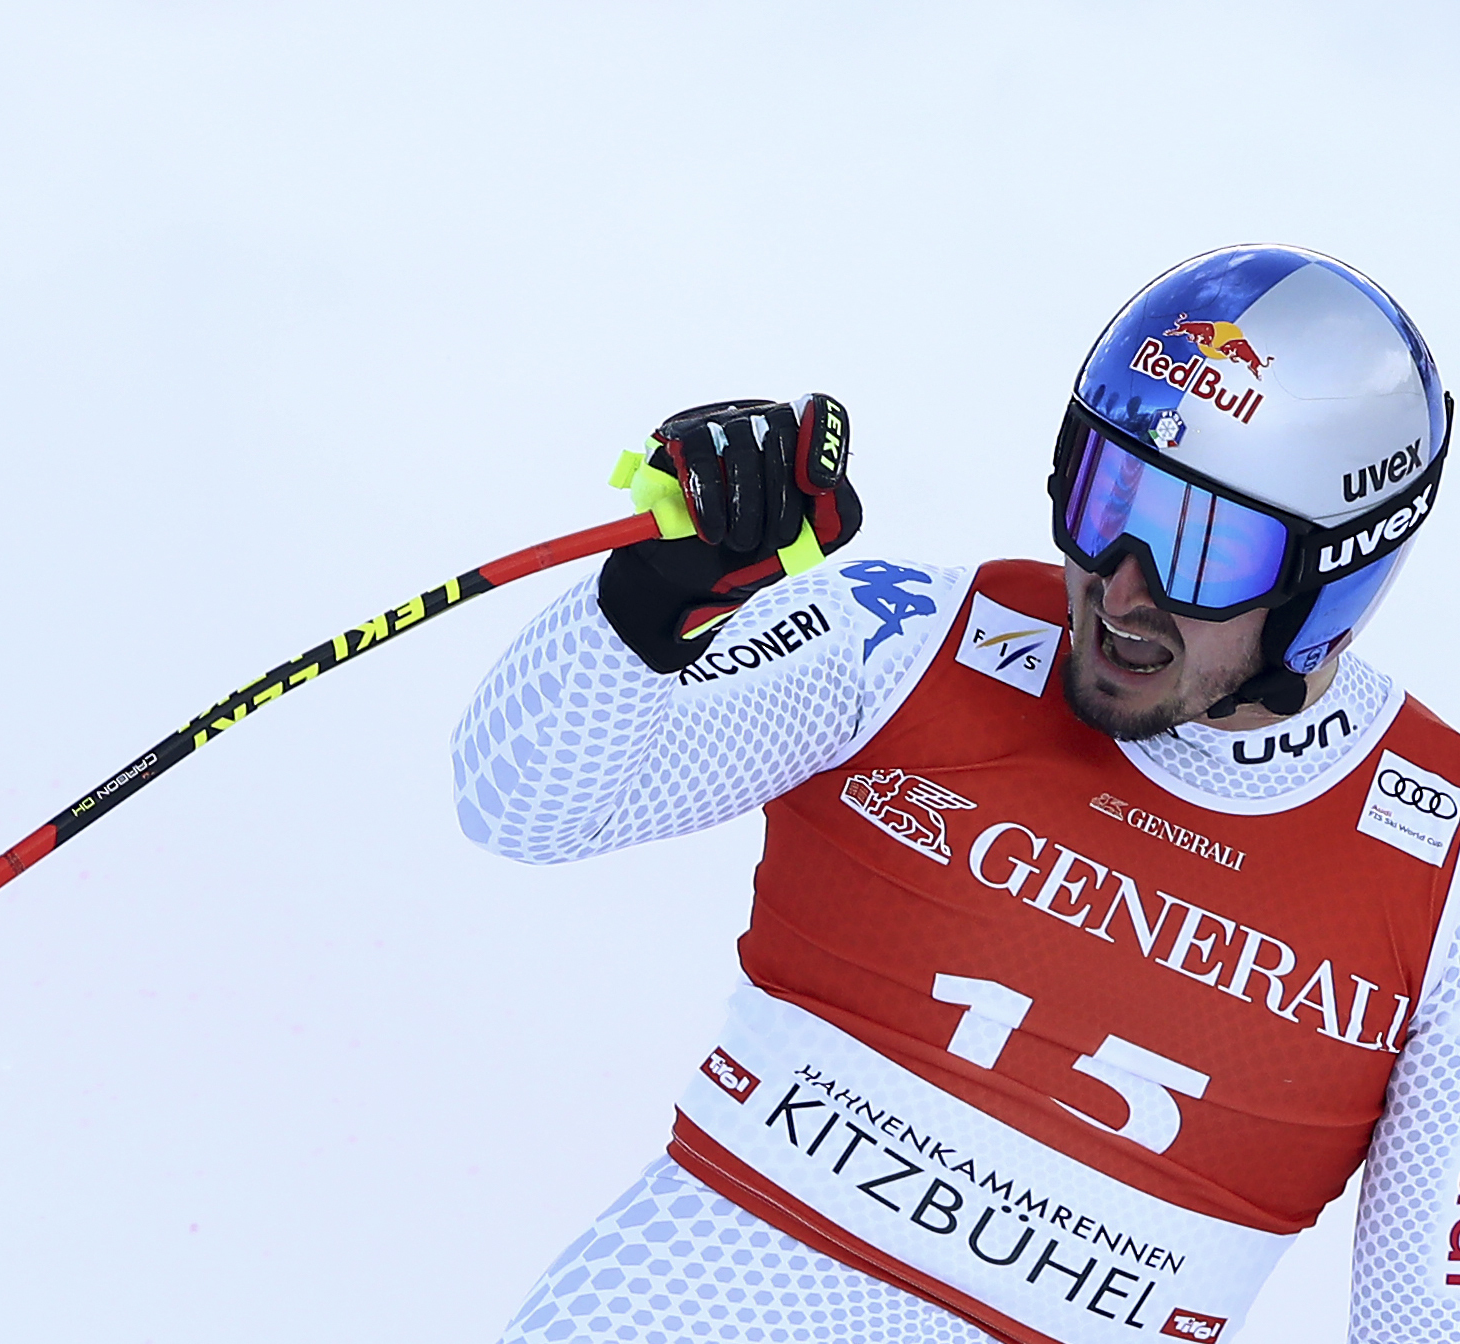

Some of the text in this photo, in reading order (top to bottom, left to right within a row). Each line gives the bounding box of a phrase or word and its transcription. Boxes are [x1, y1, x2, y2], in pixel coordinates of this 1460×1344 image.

[1132, 339, 1264, 424] Red Bull
[820, 399, 841, 471] LEKI
[1342, 438, 1422, 502] uvex
[1318, 483, 1432, 574] uvex
[332, 577, 461, 661] LEKI
[973, 628, 1042, 670] FIS
[1127, 807, 1247, 871] GENERALI
[1398, 823, 1426, 841] World
[709, 1052, 750, 1092] Tirol
[931, 972, 1211, 1155] 15
[794, 1065, 1186, 1275] HAHNENKAMMRENNEN
[765, 1083, 1157, 1330] KITZBÜHEL
[1173, 1316, 1221, 1339] Tirol
